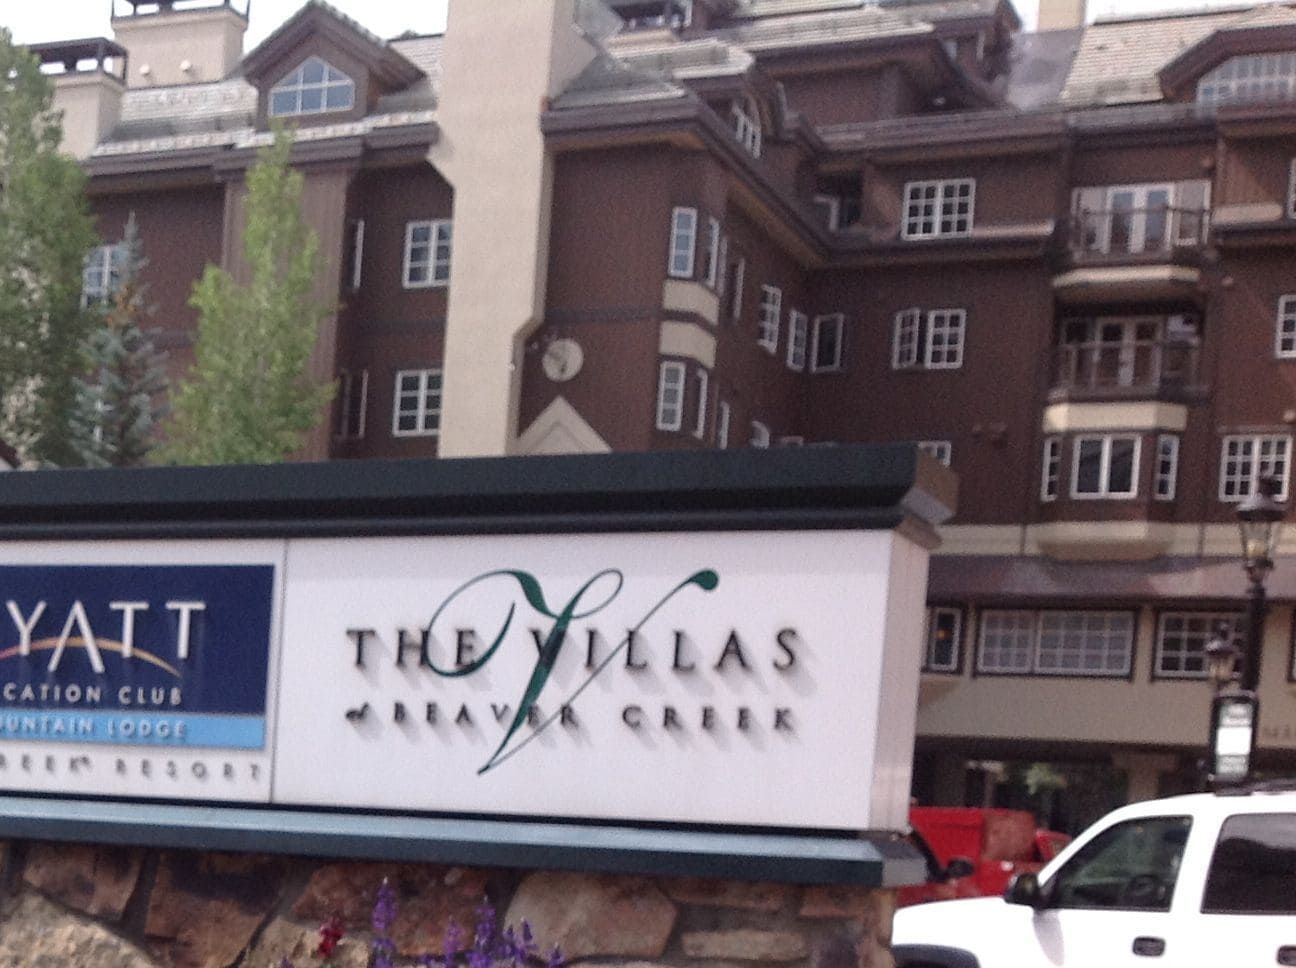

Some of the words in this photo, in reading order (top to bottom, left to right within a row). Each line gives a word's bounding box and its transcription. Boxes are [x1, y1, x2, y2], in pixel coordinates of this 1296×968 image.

[346, 628, 476, 671] THE
[529, 628, 800, 673] VILLAS
[118, 686, 183, 706] CLUB
[393, 701, 579, 729] BEAVER
[621, 704, 793, 731] CREEK
[108, 719, 187, 738] LODGE
[115, 758, 261, 780] RESORT
